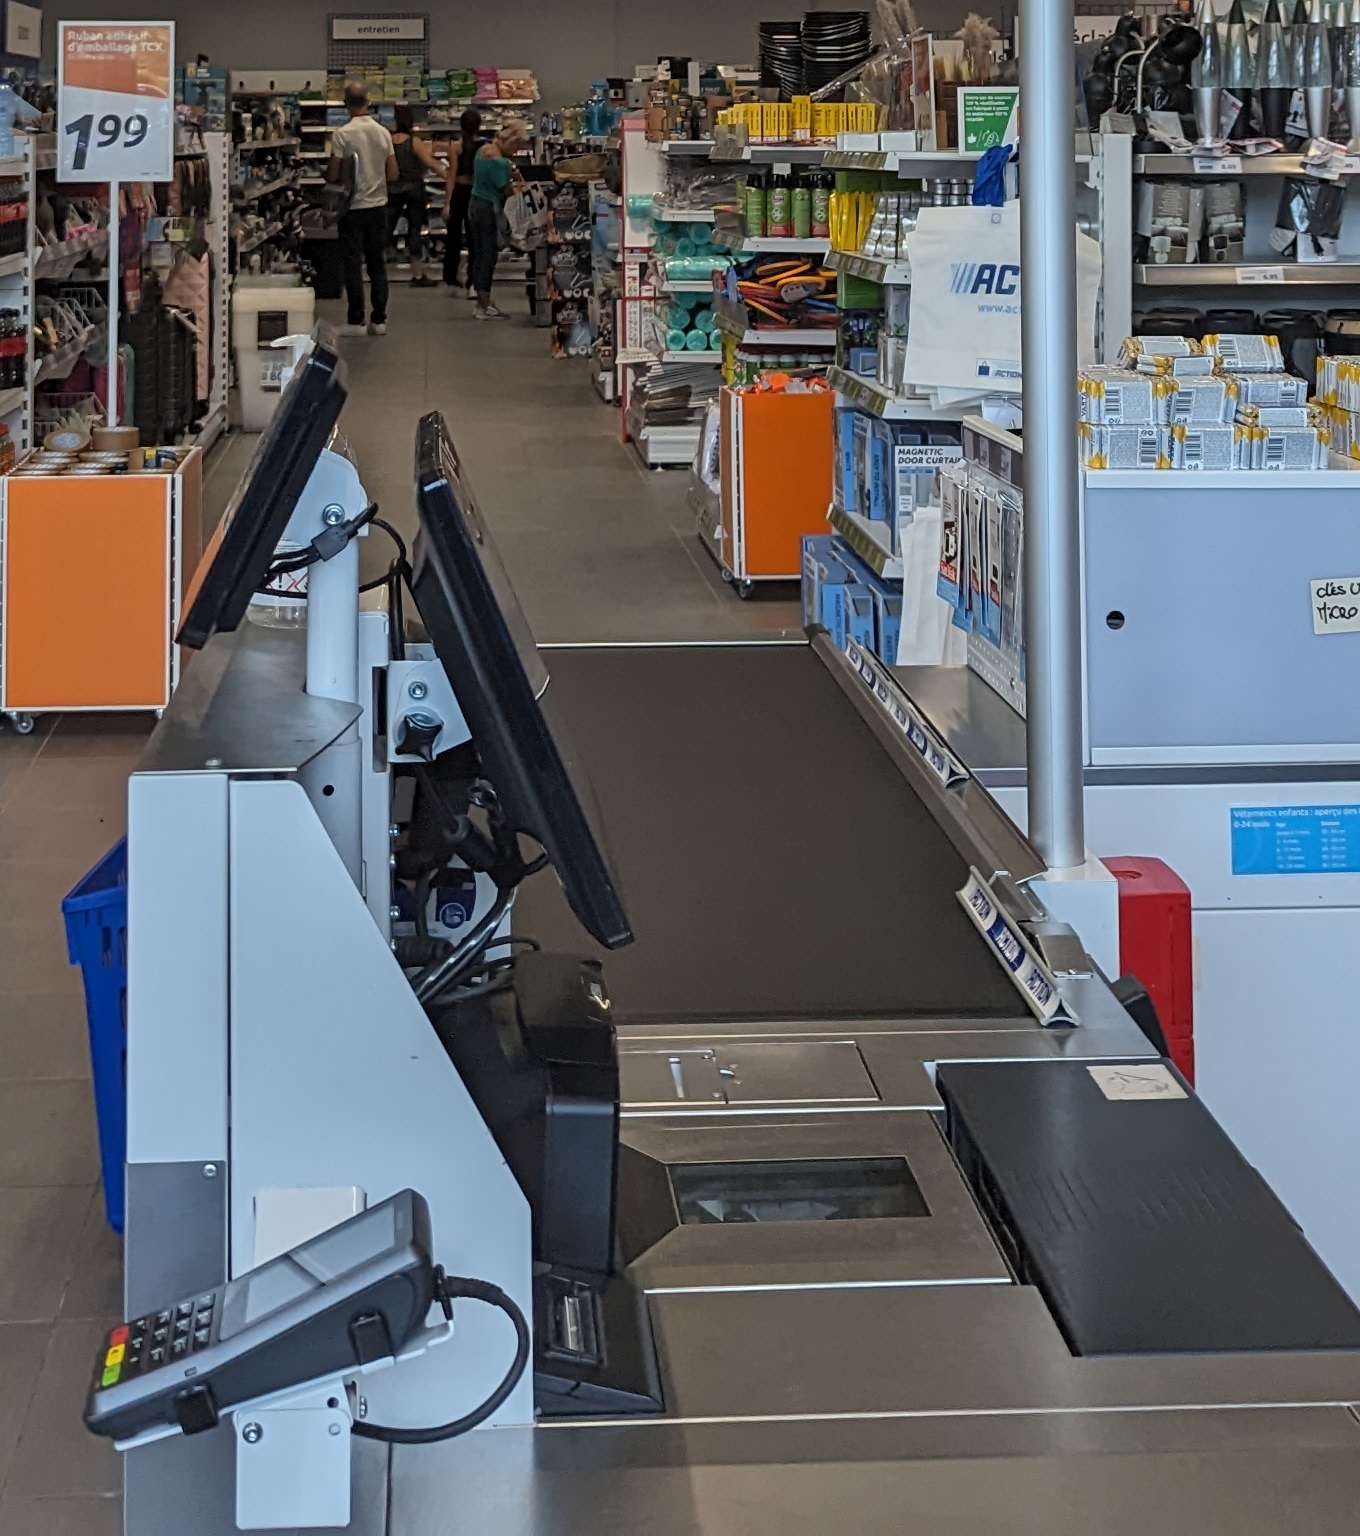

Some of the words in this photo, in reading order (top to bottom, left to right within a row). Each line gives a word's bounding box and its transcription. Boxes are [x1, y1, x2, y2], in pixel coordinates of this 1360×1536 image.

[357, 26, 400, 34] entretien
[68, 31, 104, 41] Ruban
[68, 42, 137, 53] d'emballage
[141, 43, 164, 52] TCX
[898, 448, 944, 456] MAGNETIC
